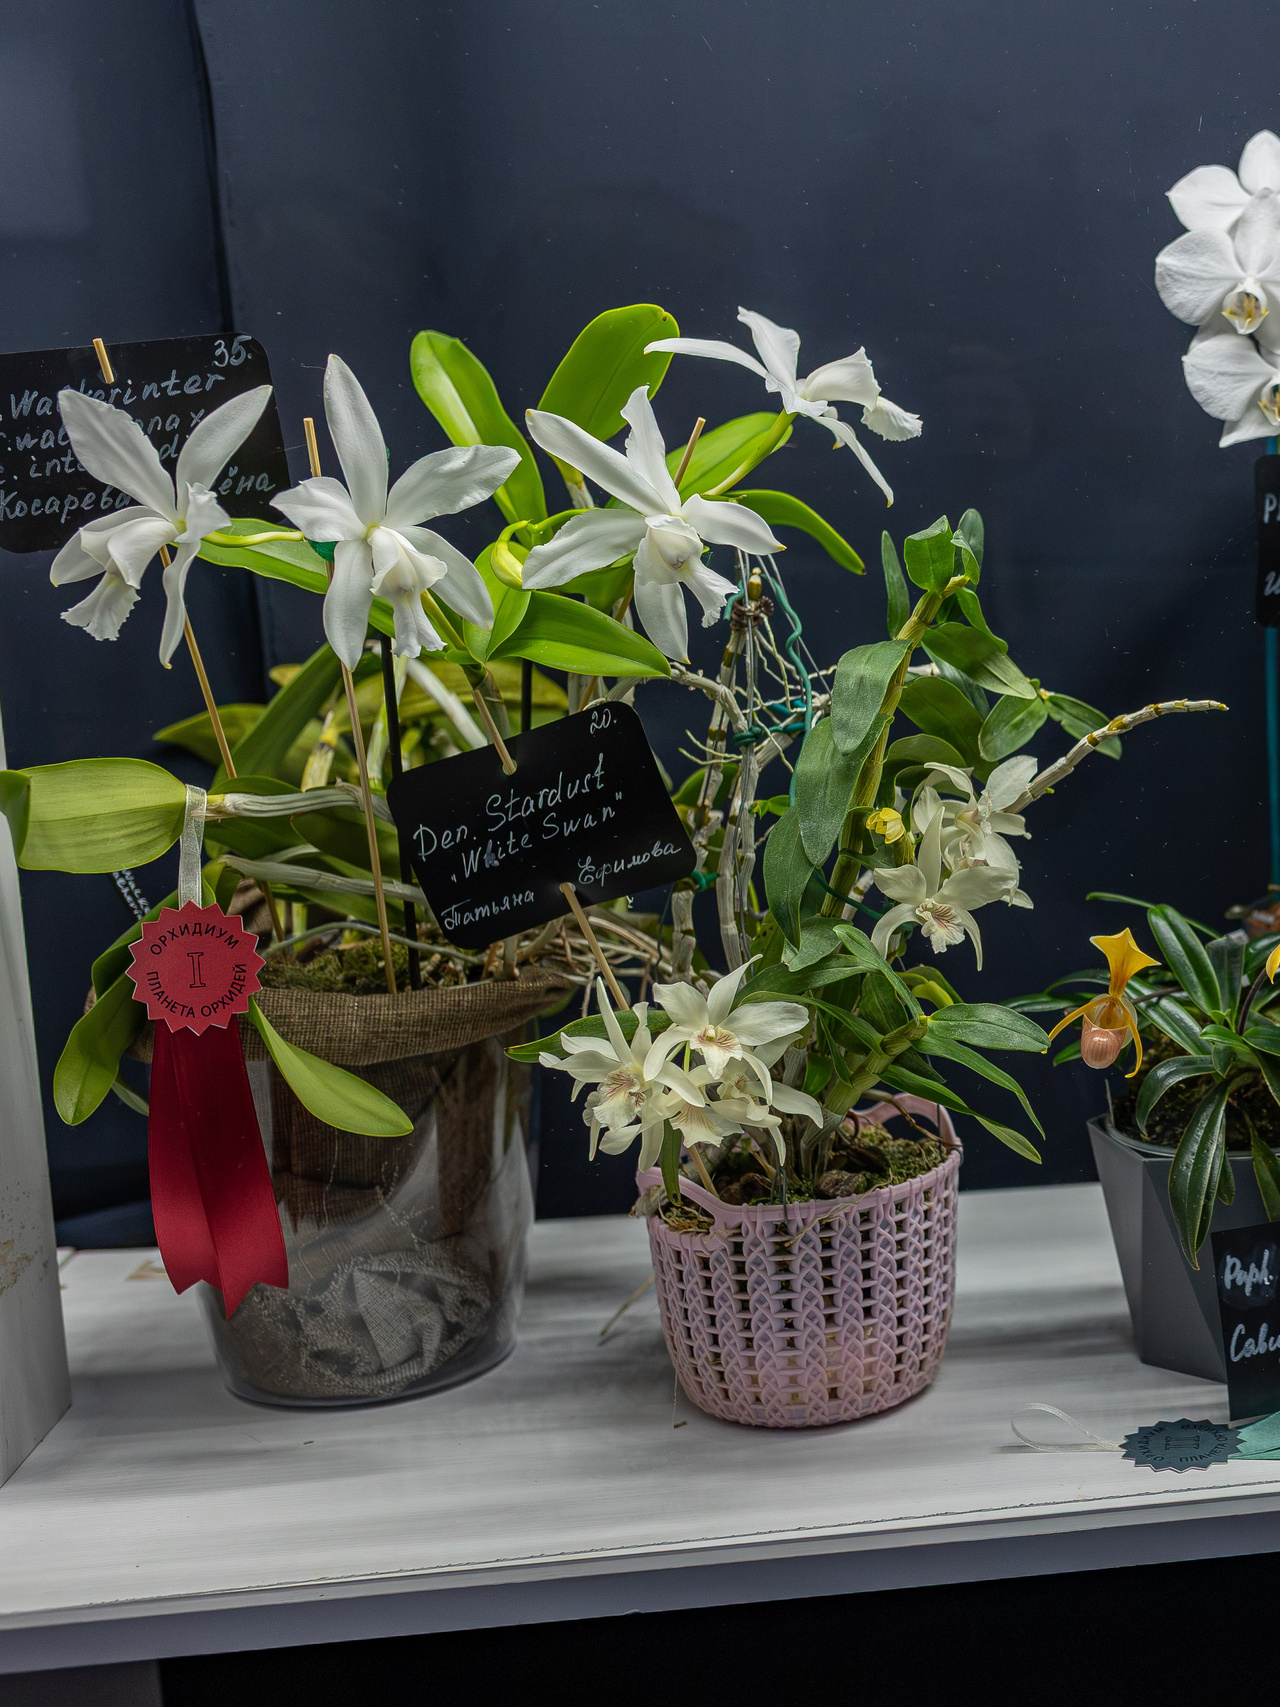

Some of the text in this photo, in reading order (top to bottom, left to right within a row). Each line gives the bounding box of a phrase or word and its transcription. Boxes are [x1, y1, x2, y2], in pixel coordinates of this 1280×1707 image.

[412, 752, 606, 862] Den. Stardust
[440, 840, 682, 931] Татьяна Ефимова
[150, 922, 240, 956] ОРХИДИУМ
[146, 963, 247, 1018] ПЛАНЕТА ОРХИДЕЙ
